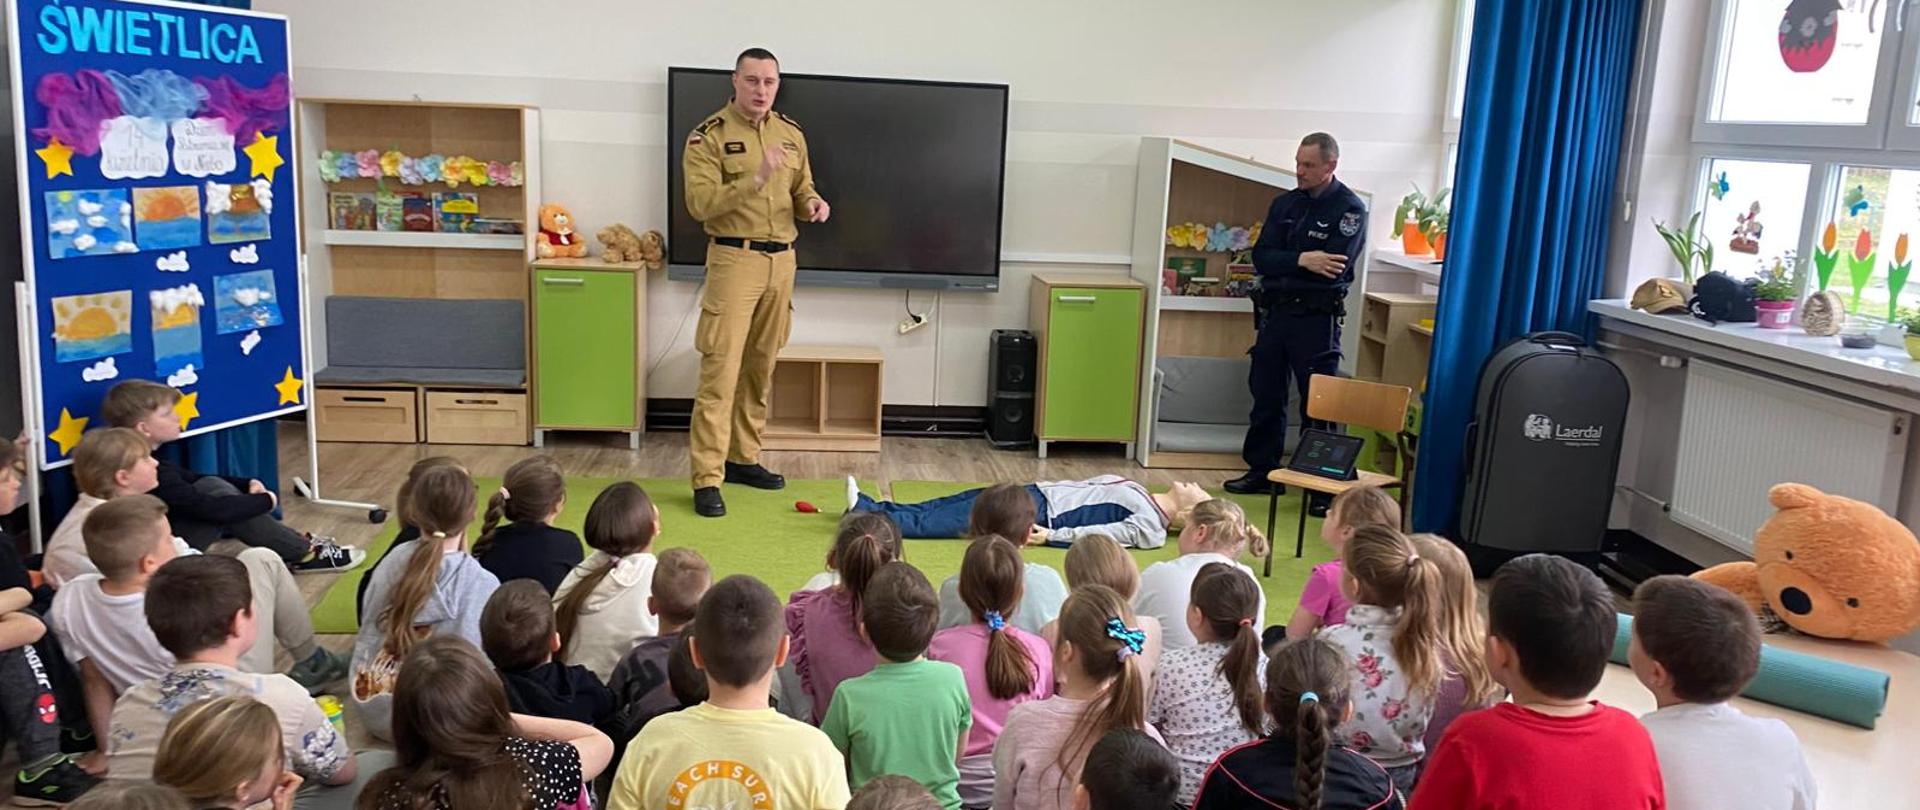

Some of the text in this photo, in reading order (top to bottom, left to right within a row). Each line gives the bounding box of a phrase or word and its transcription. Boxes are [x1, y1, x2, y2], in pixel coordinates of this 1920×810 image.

[37, 0, 264, 64] ŚWIETLICA
[1556, 424, 1603, 438] Laerdal
[731, 765, 769, 810] SUR
